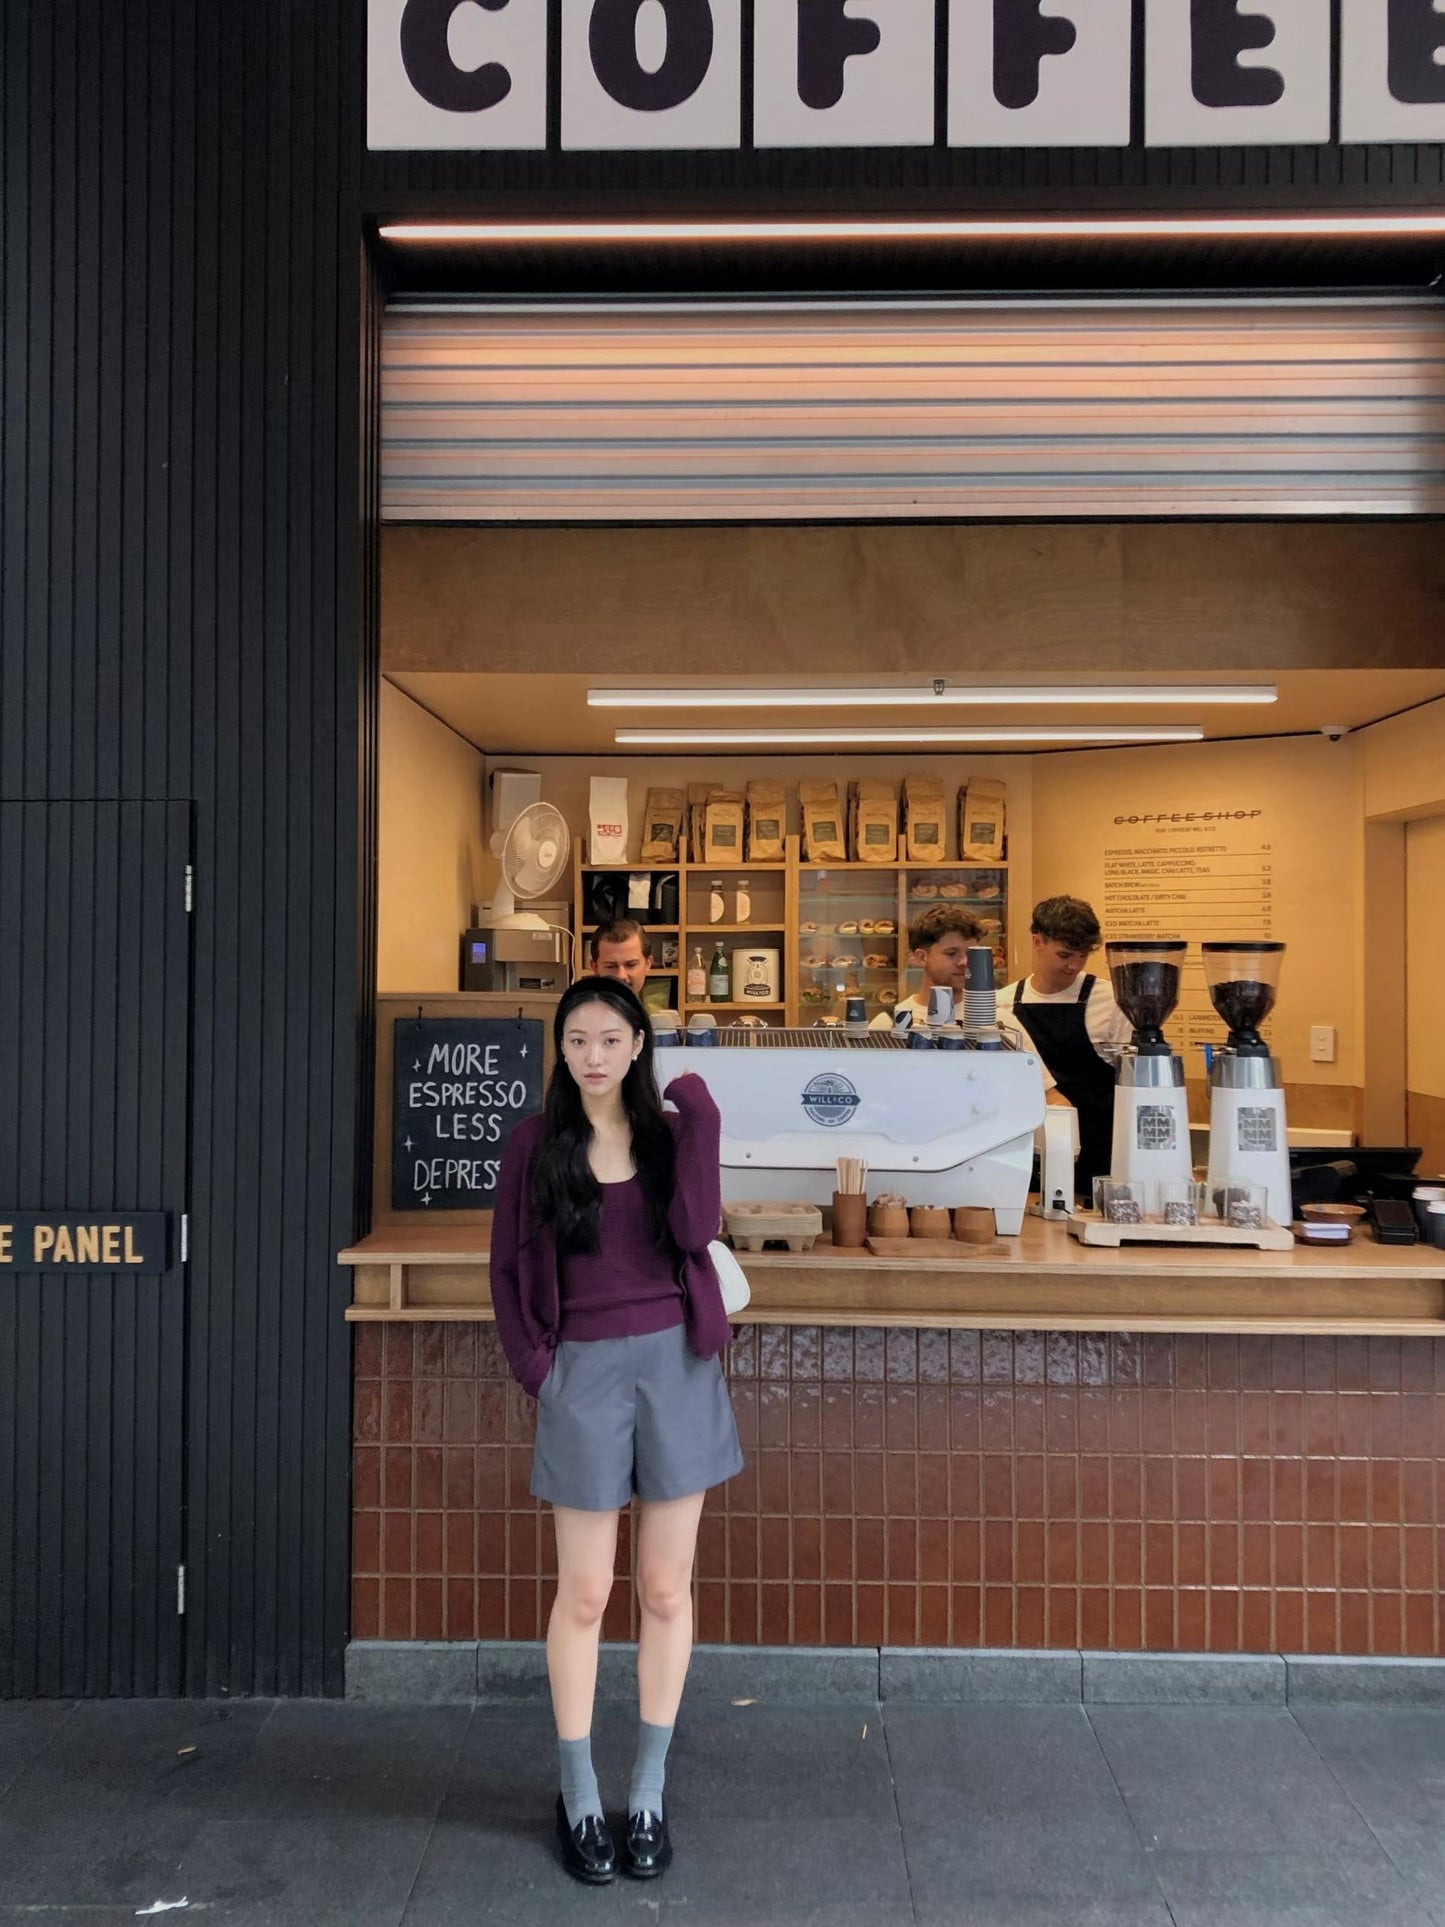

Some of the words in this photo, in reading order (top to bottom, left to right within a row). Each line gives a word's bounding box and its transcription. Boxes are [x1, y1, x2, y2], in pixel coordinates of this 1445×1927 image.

[1114, 813, 1195, 825] COFFEE
[1203, 810, 1262, 821] SHOP
[427, 1043, 500, 1076] MORE
[409, 1080, 527, 1109] ESPRESSO
[436, 1113, 502, 1142] LESS
[33, 1225, 144, 1264] PANEL
